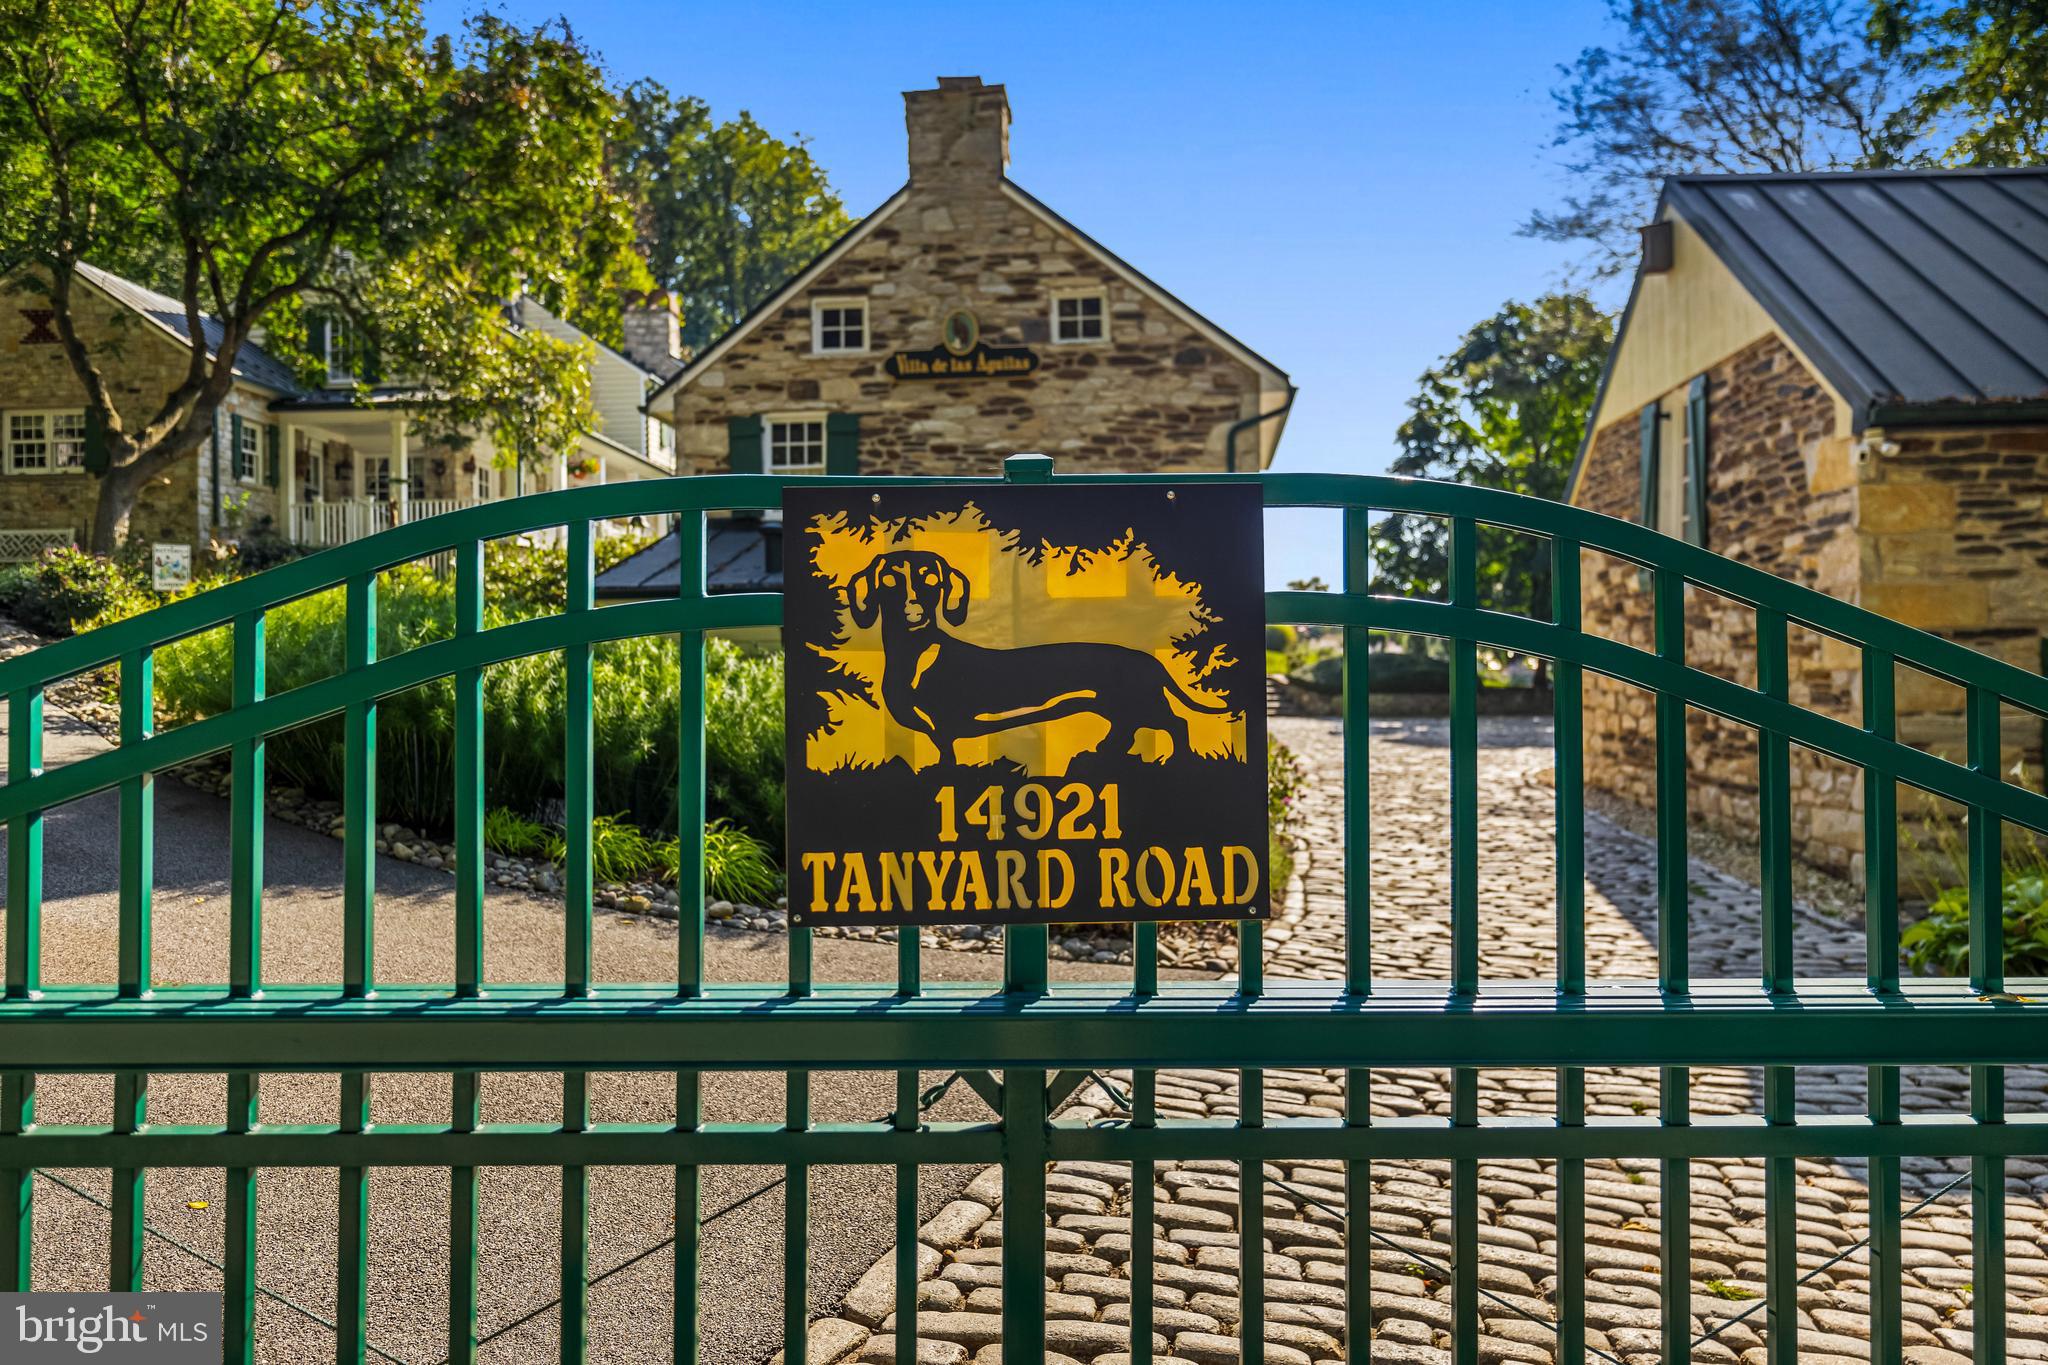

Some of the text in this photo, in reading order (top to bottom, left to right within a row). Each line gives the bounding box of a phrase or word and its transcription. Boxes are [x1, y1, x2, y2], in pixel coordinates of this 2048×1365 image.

[896, 353, 929, 375] Villa
[931, 358, 948, 374] de
[951, 357, 973, 373] las
[934, 783, 1123, 842] 14921
[801, 845, 1259, 913] TANYARD ROAD
